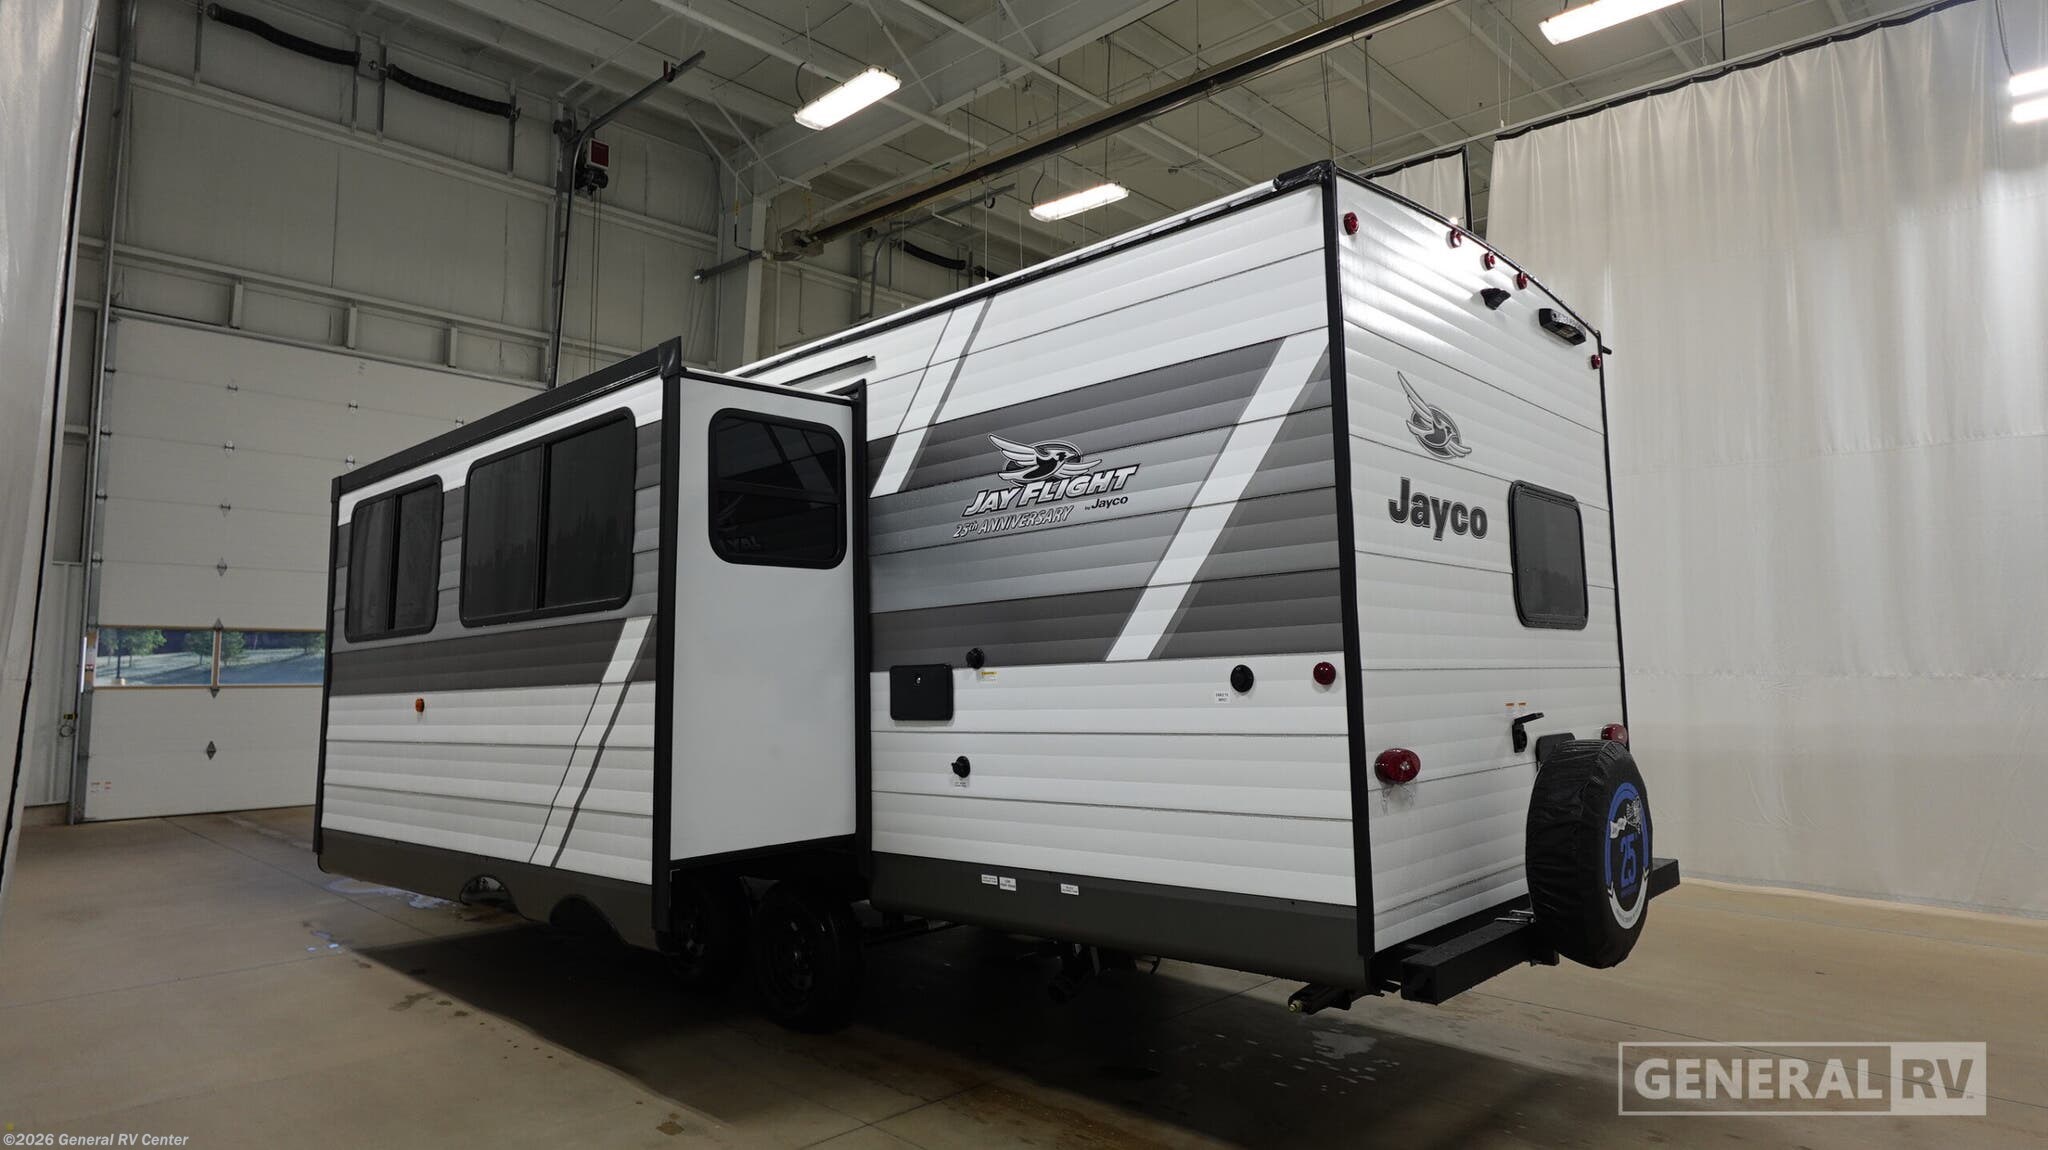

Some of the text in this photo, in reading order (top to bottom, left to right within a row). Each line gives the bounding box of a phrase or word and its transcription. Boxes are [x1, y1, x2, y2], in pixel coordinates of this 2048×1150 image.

[962, 463, 1141, 518] JAY FLIGHT
[1092, 496, 1129, 509] Jayco
[1388, 476, 1489, 541] Jayco
[953, 505, 1074, 539] 25th ANNIVERSARY
